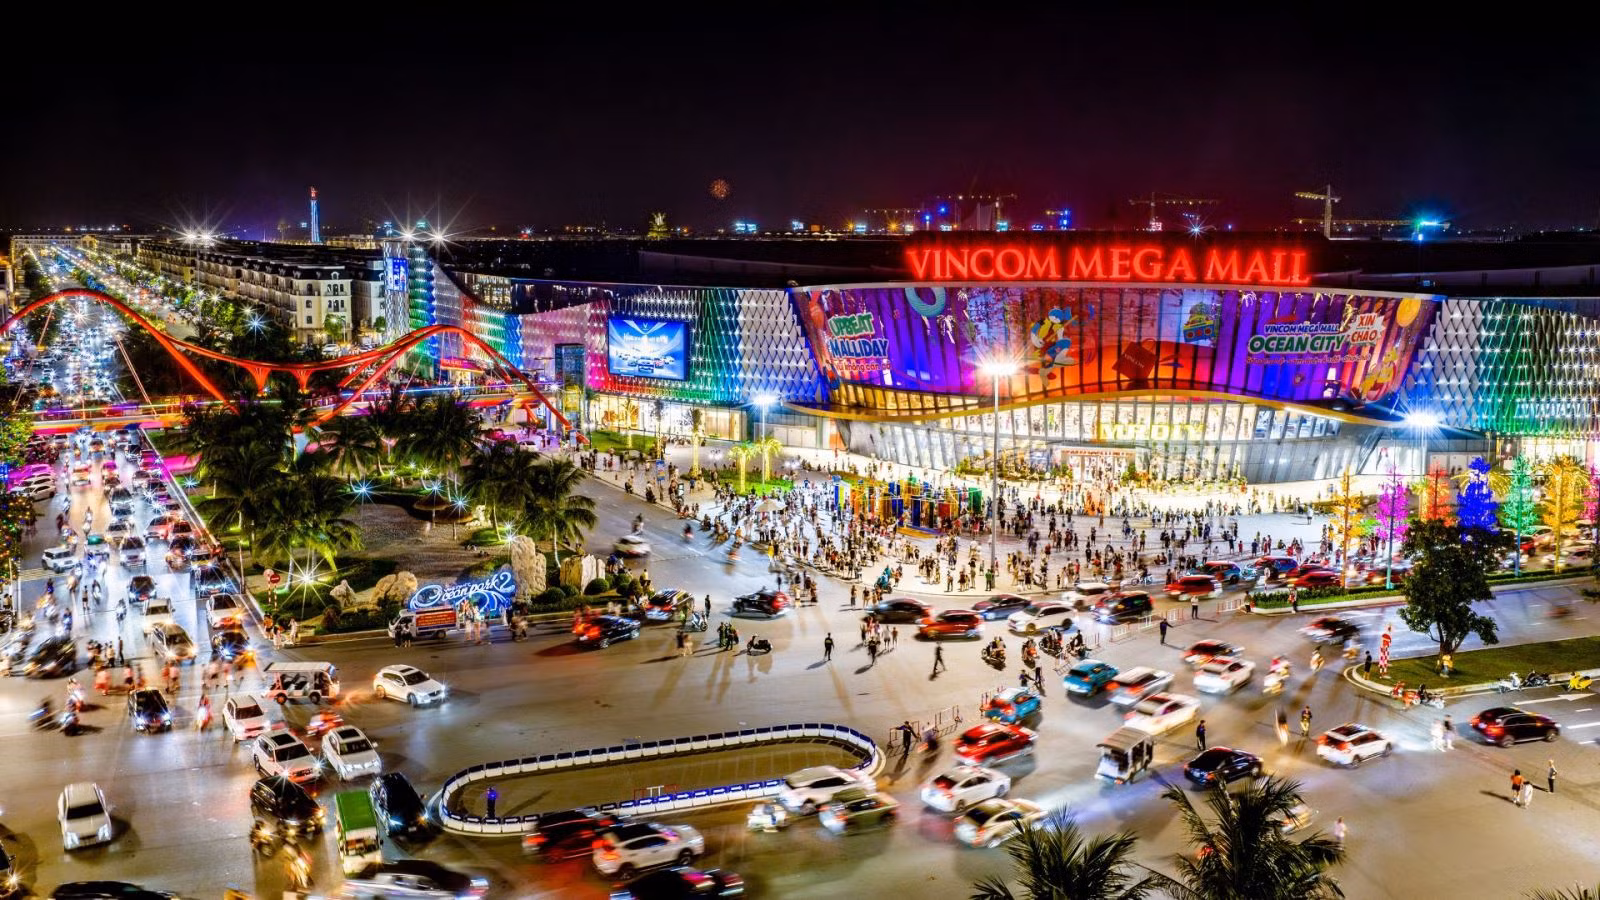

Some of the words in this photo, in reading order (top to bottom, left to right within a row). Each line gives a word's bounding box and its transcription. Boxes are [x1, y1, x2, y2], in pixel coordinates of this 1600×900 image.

[906, 247, 1062, 280] VINCOM
[1069, 247, 1197, 281] MEGA
[1204, 249, 1312, 285] MALL
[829, 313, 875, 336] UPBEAT
[1264, 324, 1297, 333] VINCOM
[1298, 324, 1319, 333] MEGA
[1320, 324, 1339, 332] MALL
[1358, 315, 1377, 327] XIN
[829, 339, 888, 358] MALLIDAY
[1249, 335, 1309, 353] OCEAN
[1309, 335, 1346, 352] CITY
[410, 584, 468, 609] Ocean
[469, 575, 500, 595] park
[500, 571, 516, 592] 2
